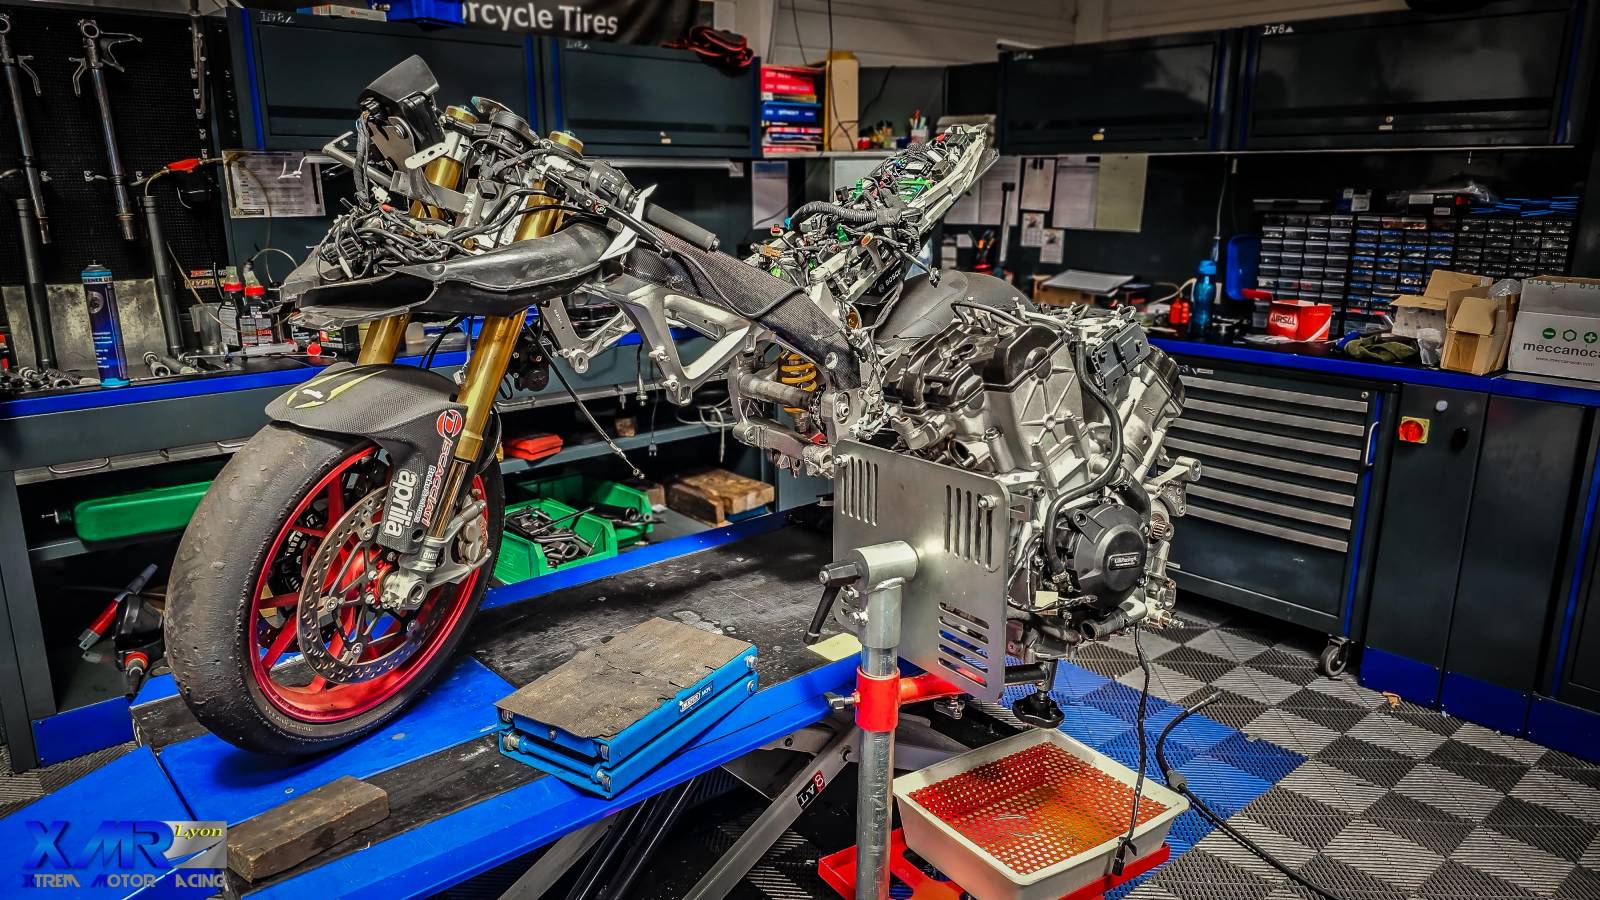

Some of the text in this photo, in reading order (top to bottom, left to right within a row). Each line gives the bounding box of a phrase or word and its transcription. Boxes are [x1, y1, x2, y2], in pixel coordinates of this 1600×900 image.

[558, 4, 619, 35] Tires
[1523, 342, 1600, 359] meccanoc
[384, 469, 417, 538] aprilia
